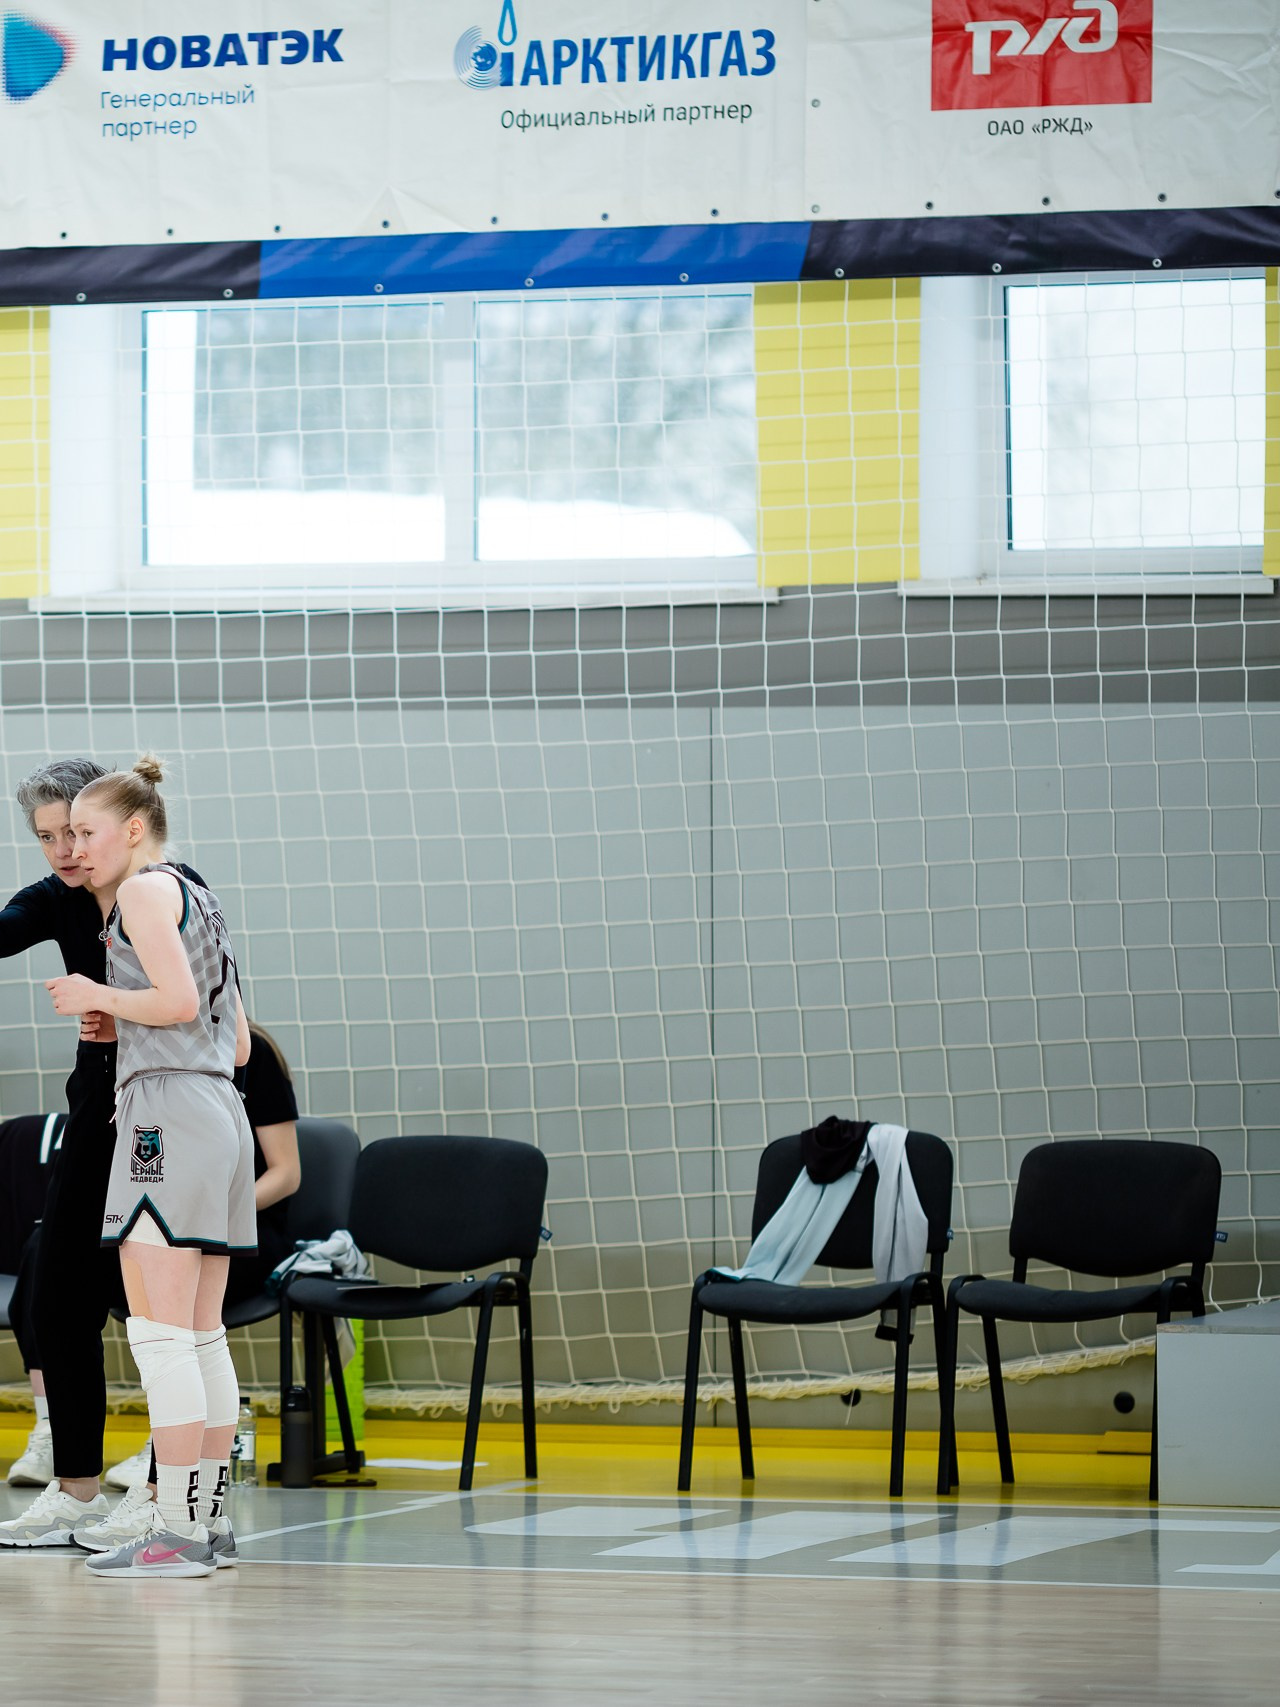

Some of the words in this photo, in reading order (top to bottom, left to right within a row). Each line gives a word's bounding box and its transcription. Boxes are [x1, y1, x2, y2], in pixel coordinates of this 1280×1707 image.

[102, 28, 344, 71] НОВАТЭК
[520, 29, 776, 86] АРКТИКГАЗ
[100, 84, 255, 112] Генеральный
[102, 119, 197, 141] партнер
[501, 105, 656, 132] Официальный
[662, 103, 753, 126] партнер
[987, 120, 1024, 136] ОАО
[1031, 118, 1093, 135] «РЖД»
[105, 1214, 124, 1224] STK
